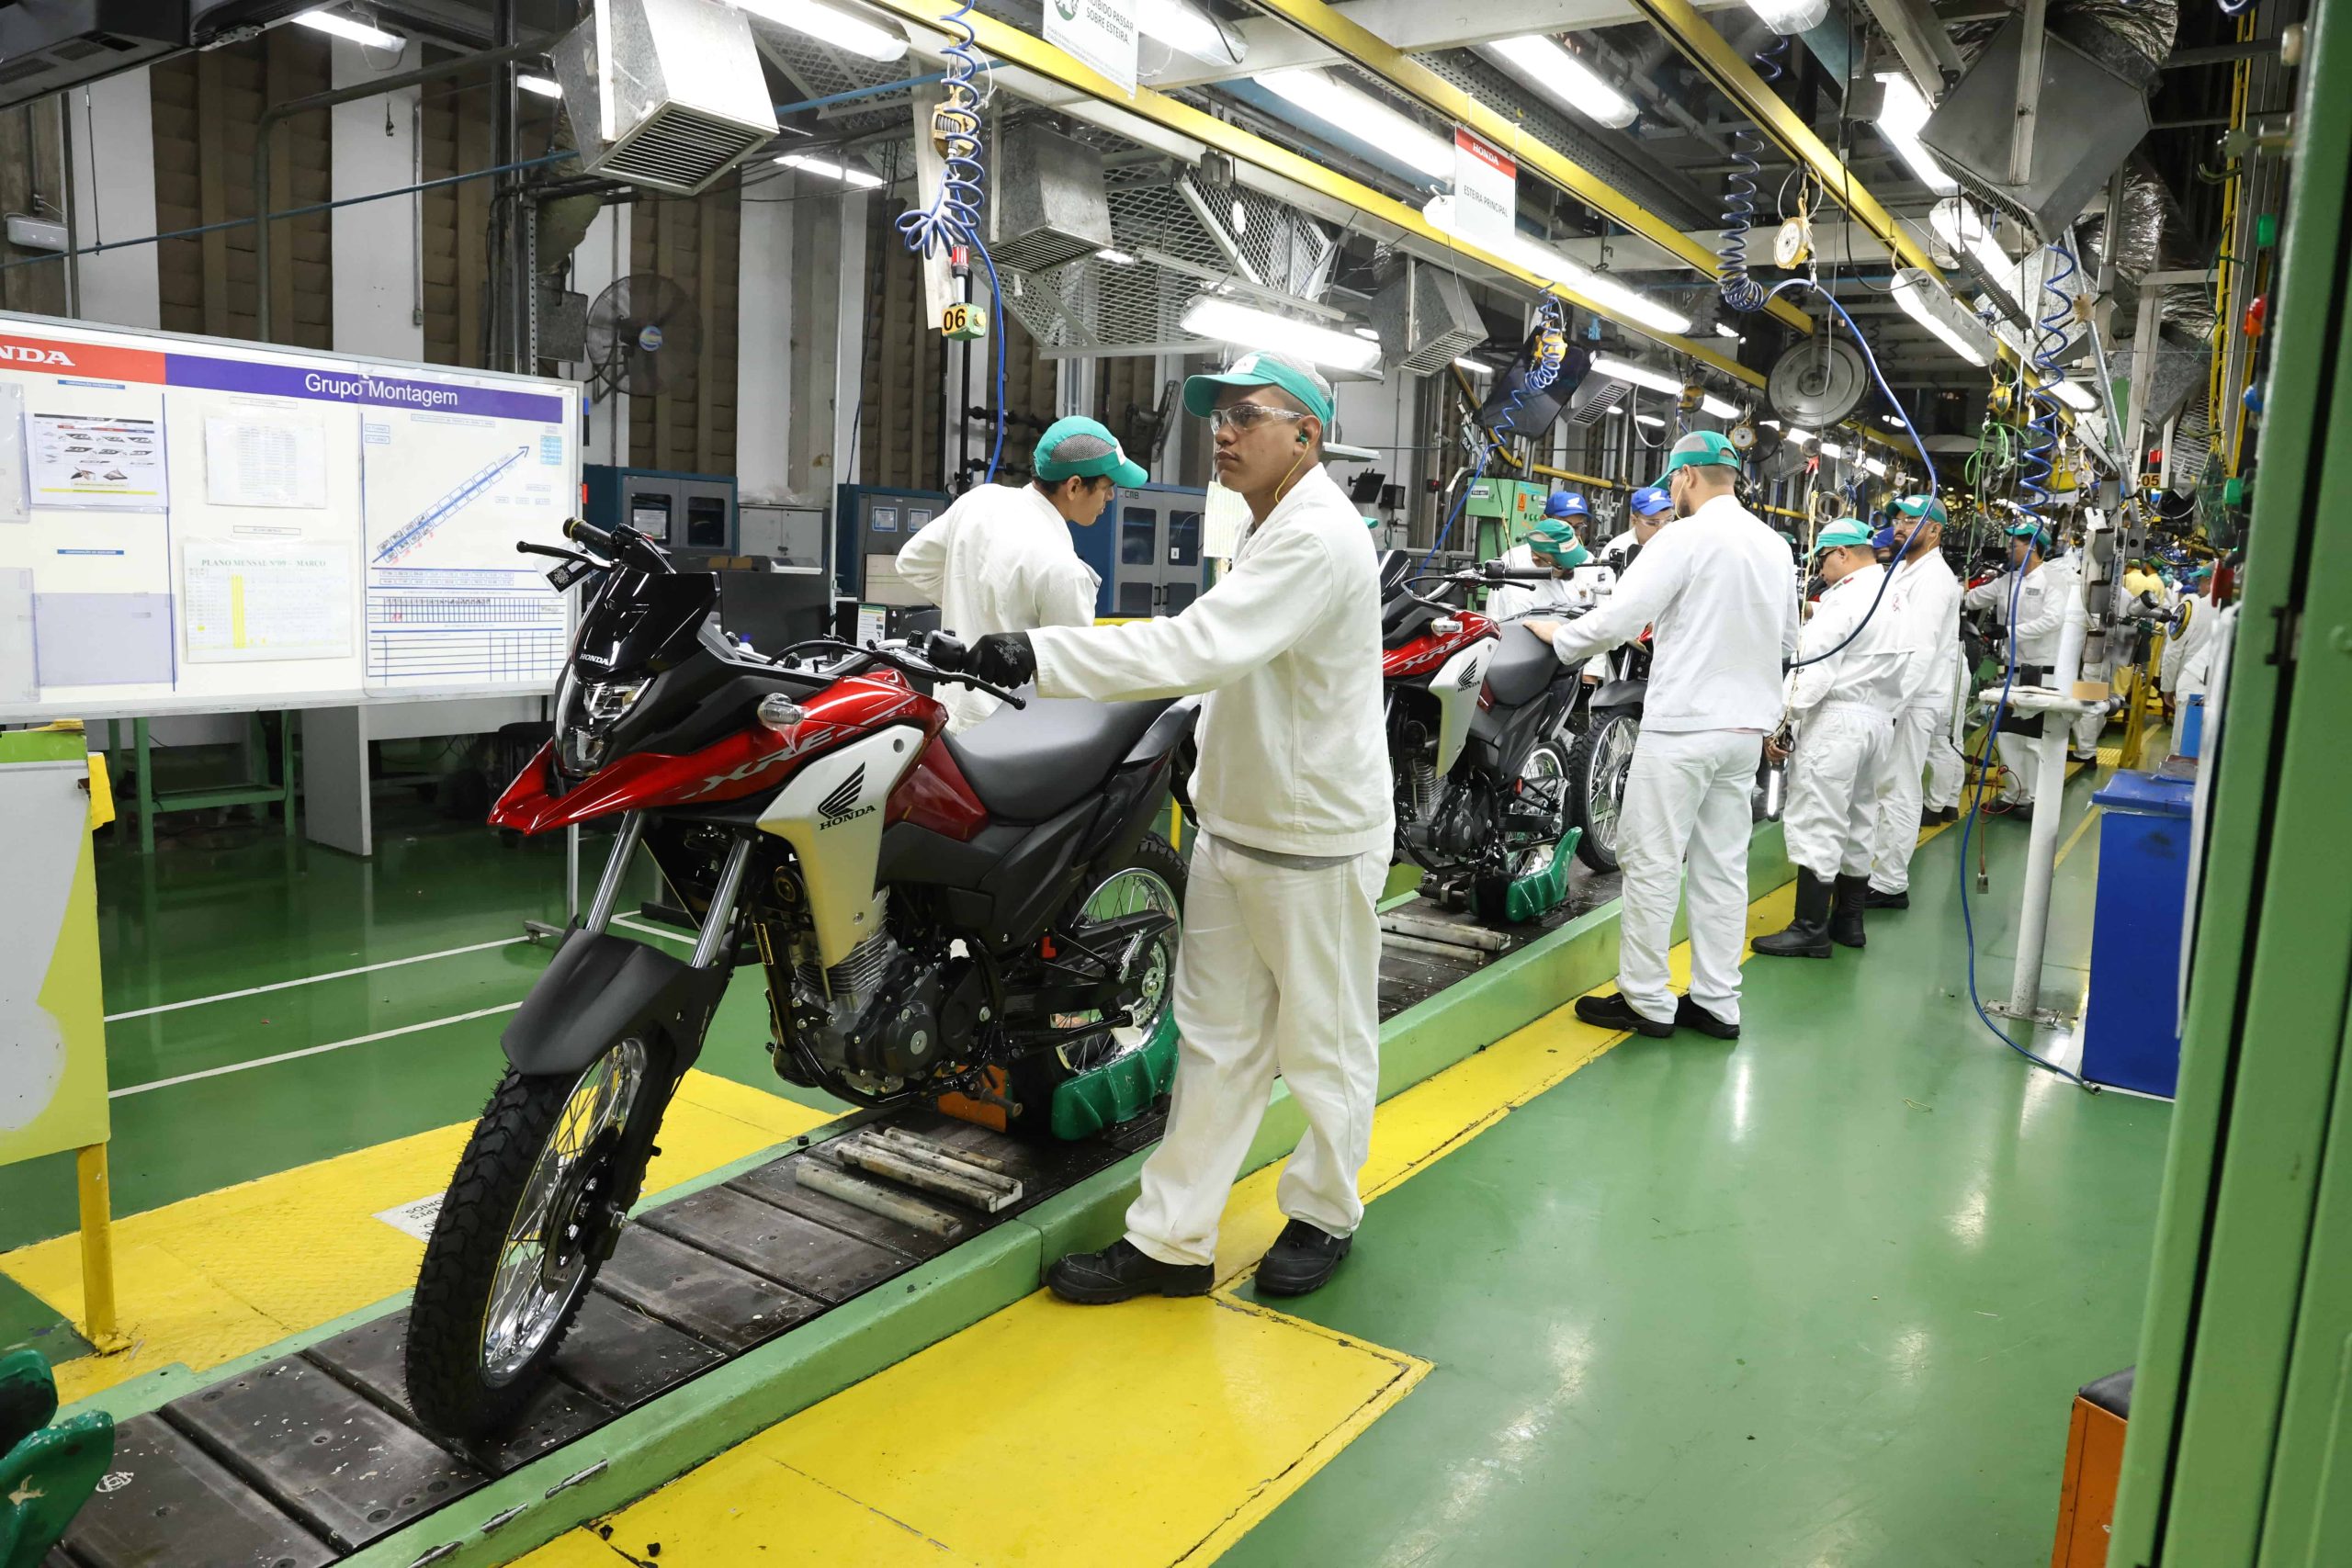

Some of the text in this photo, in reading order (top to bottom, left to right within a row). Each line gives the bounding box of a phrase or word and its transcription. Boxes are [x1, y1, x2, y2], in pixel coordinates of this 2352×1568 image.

[1086, 7, 1131, 45] SOBRE ESTEIRA.
[1113, 10, 1134, 33] PASSAR
[1472, 142, 1499, 165] HONDA
[1464, 185, 1509, 218] ESTEIRA PRINCIPAL
[944, 309, 966, 331] 06
[305, 373, 458, 407] Grupo Montagem
[2142, 474, 2159, 486] 05
[201, 558, 232, 567] PLANO
[579, 653, 609, 666] HONDA
[1457, 680, 1481, 693] HONDA
[702, 725, 837, 794] XRE
[819, 804, 877, 830] HONDA
